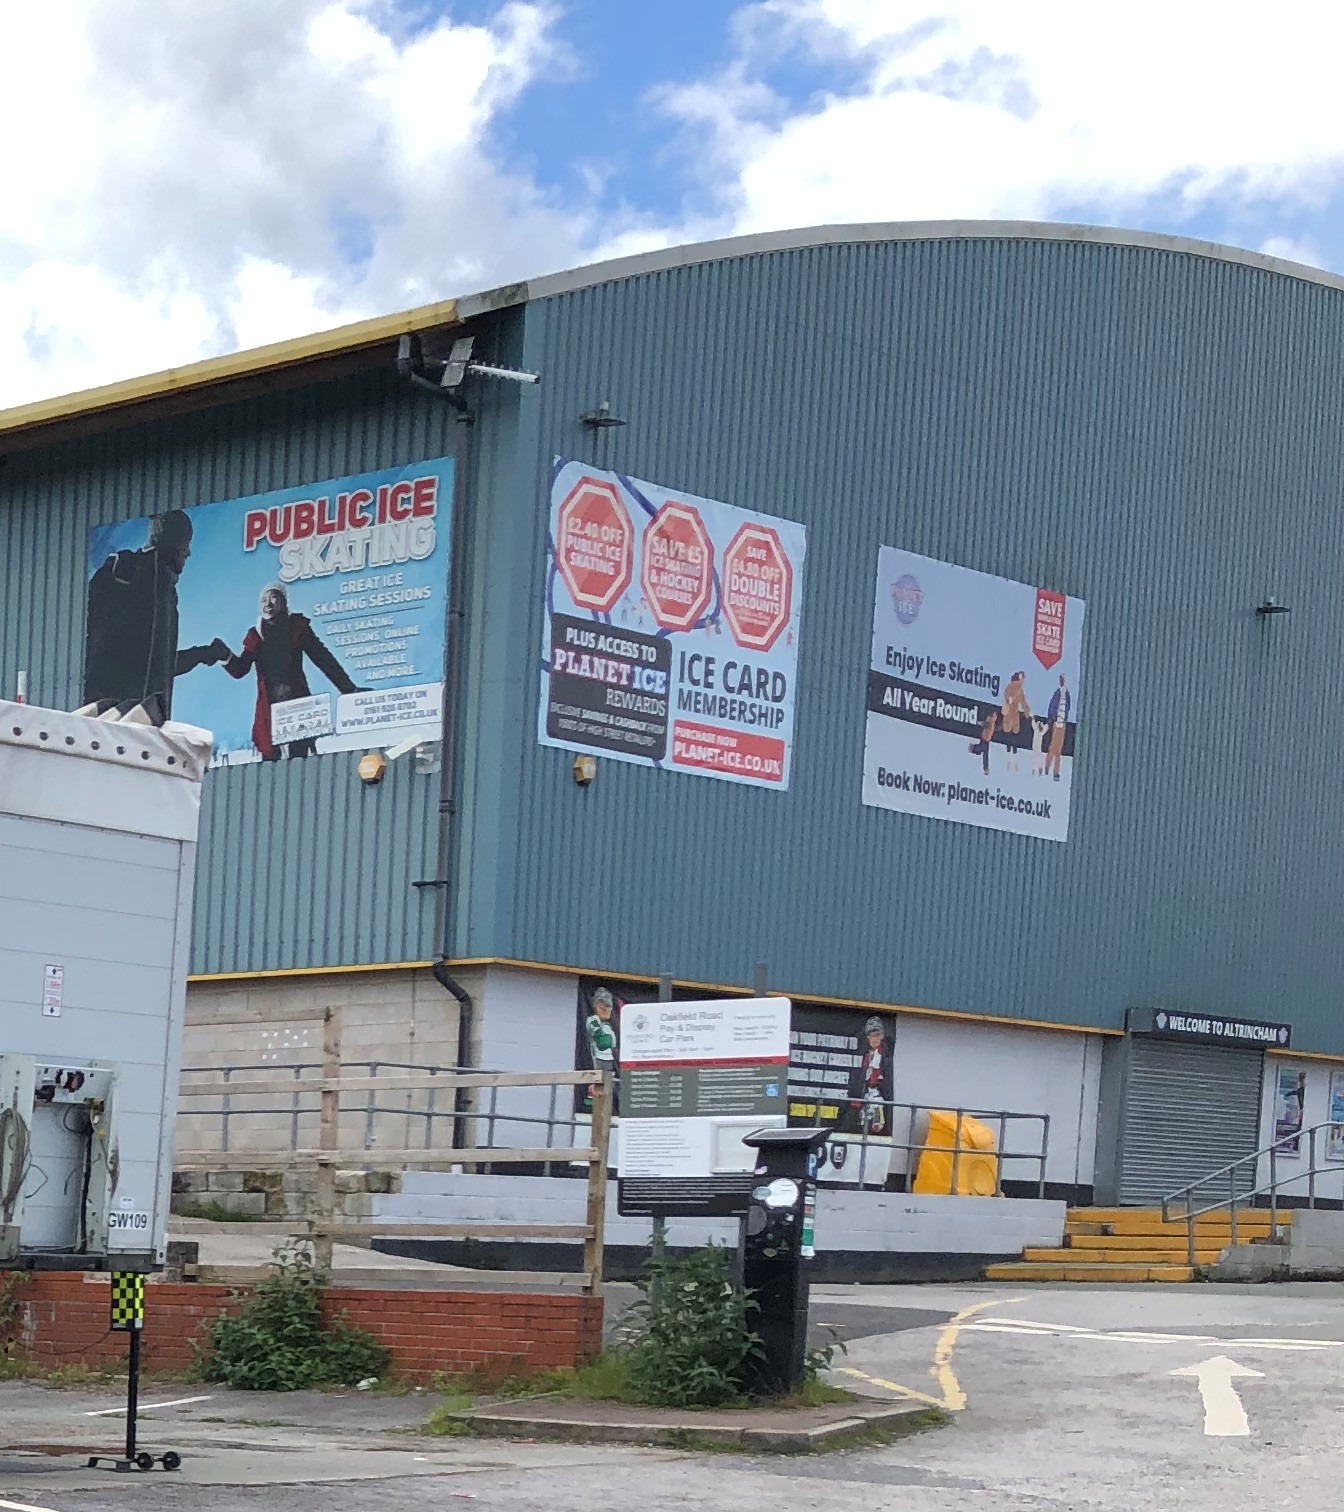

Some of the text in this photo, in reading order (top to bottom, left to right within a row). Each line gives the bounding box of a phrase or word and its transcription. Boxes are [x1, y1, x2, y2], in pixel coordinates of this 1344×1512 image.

[245, 476, 437, 550] PUBLIC ICE
[601, 526, 623, 544] OFF
[652, 536, 686, 558] SAVE
[279, 519, 435, 581] SKATING
[567, 535, 622, 562] PUBLIC ICE
[746, 546, 767, 561] SAVE
[570, 551, 615, 575] SKATING
[761, 565, 781, 582] OFF
[340, 572, 403, 595] GREAT ICE
[660, 571, 700, 592] HOCKEY
[731, 574, 780, 601] DOUBLE
[314, 586, 431, 616] SKATING SESSIONS
[730, 592, 780, 615] DISCOUNTS
[1038, 598, 1063, 618] SAVE
[1036, 622, 1061, 640] SKATE
[566, 627, 657, 663] PLUS ACCESS TO
[554, 648, 667, 694] PLANET ICE
[679, 651, 787, 703] ICE CARD
[886, 645, 1000, 697] Enjoy Ice Skating
[606, 688, 667, 717] REWARDS
[677, 687, 785, 730] MEMBERSHIP
[883, 687, 978, 725] All Year Round
[716, 735, 737, 748] NOW
[674, 740, 781, 774] PLANET-ICE.CO.UK
[877, 767, 1051, 819] Book Now: planet-ice.co.uk
[660, 1011, 724, 1022] Oakfield Road
[660, 1024, 674, 1033] Pay
[686, 1023, 715, 1032] Display
[1169, 1015, 1277, 1042] WELCOME TO ALTRINCHAM
[660, 1035, 674, 1043] Car
[676, 1033, 694, 1042] Park
[808, 1154, 817, 1176] P
[108, 1212, 147, 1228] GW109
